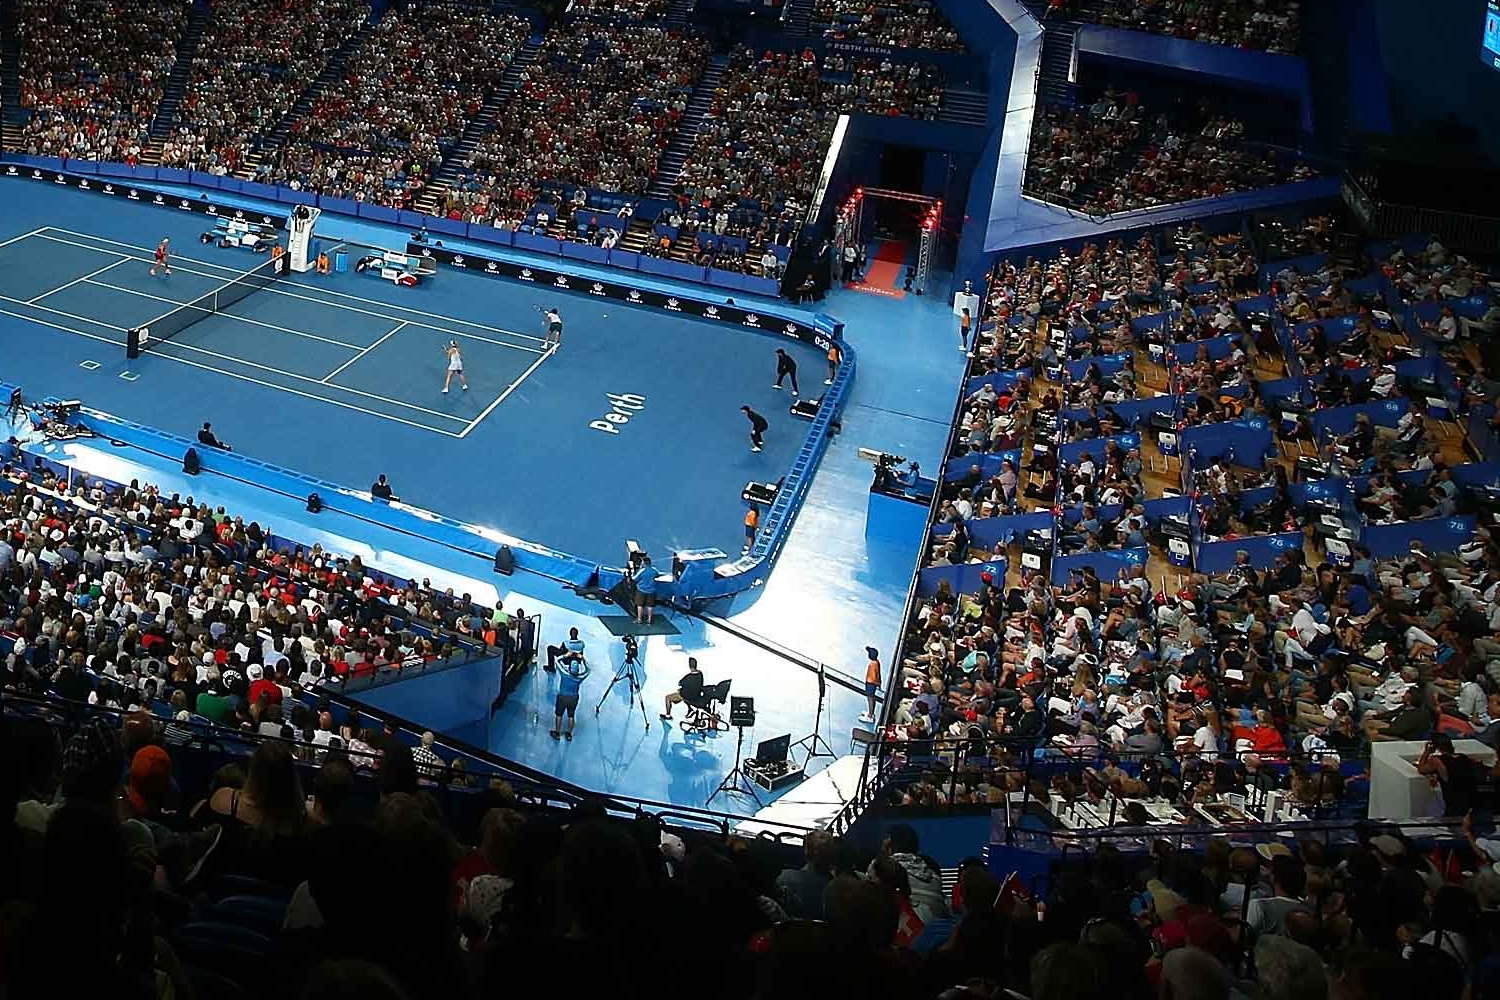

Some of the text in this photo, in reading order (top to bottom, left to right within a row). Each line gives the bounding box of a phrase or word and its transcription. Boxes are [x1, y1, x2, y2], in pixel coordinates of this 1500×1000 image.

[833, 43, 862, 52] PERTH
[814, 336, 830, 351] 0:20
[589, 392, 646, 434] Perth
[1270, 537, 1284, 547] 76
[1126, 551, 1139, 561] 74
[986, 564, 997, 573] 72
